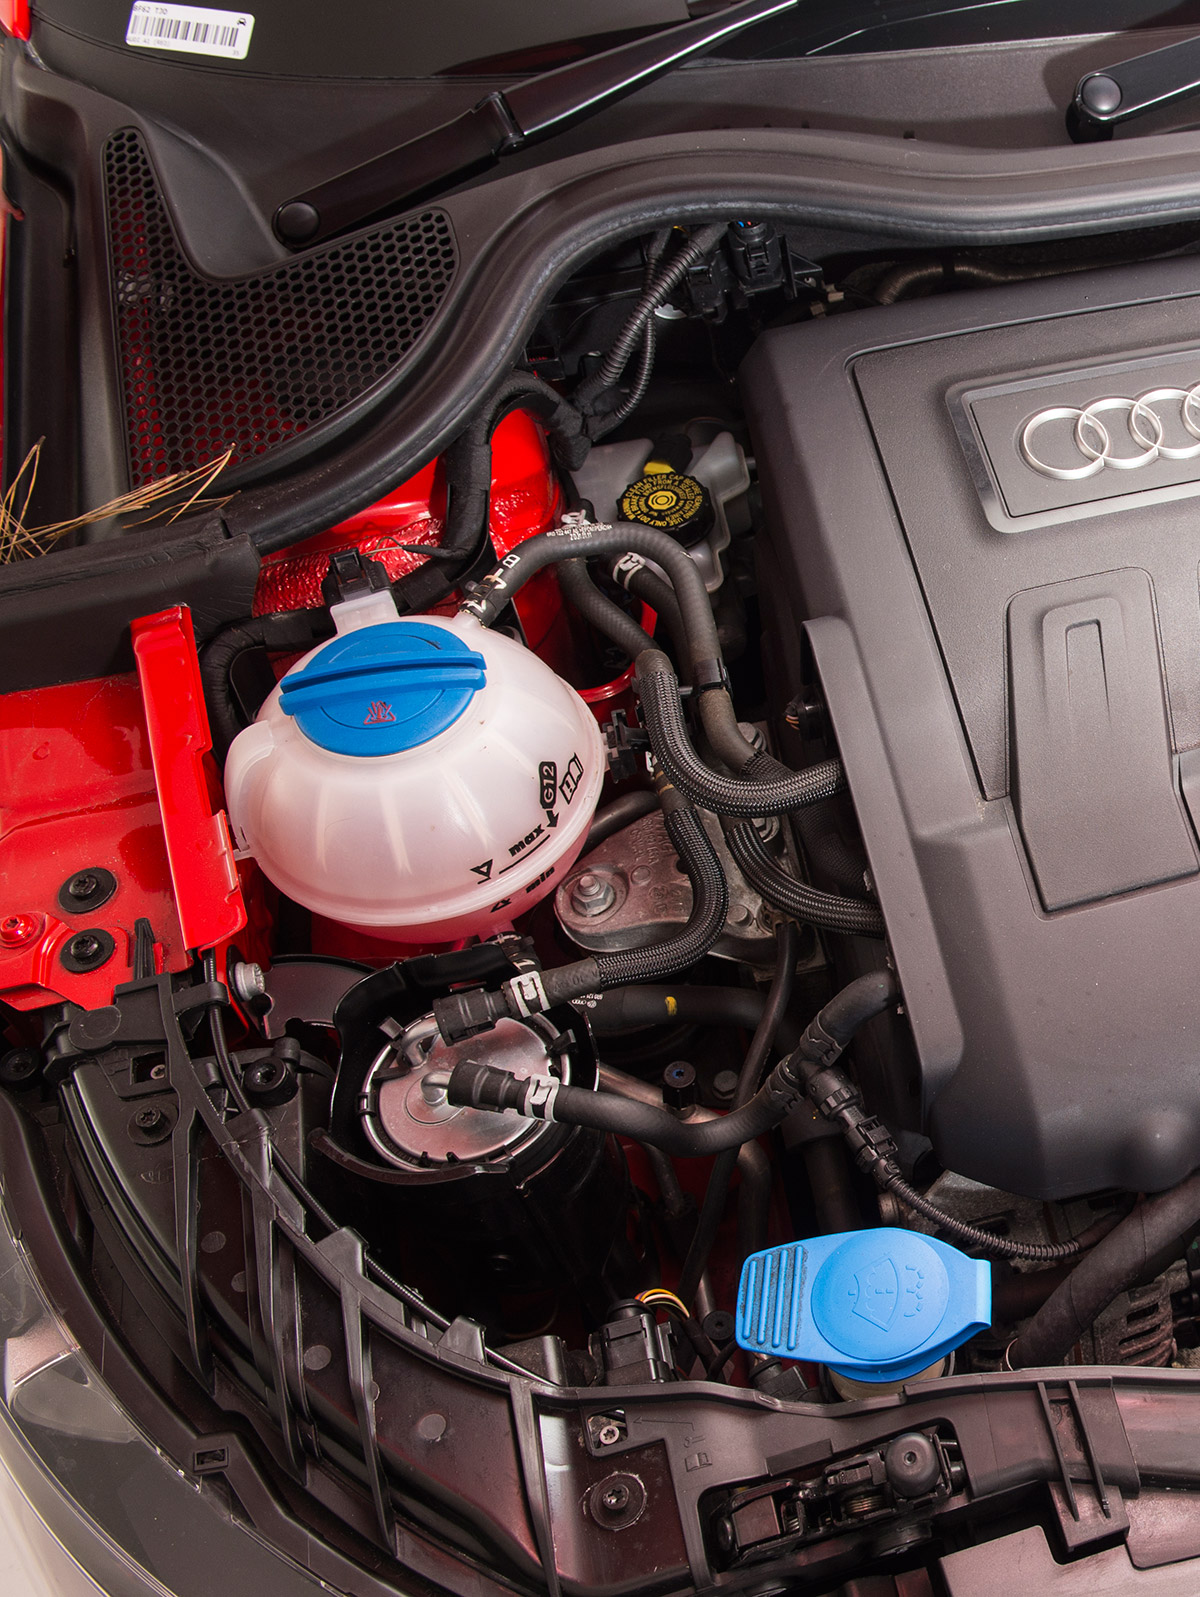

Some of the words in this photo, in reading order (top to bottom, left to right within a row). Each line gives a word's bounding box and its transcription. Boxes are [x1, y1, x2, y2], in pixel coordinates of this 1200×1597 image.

[625, 482, 644, 498] CLEAN
[644, 474, 667, 484] FILLER
[635, 483, 653, 495] FLUID
[630, 495, 640, 512] BRAKE
[637, 513, 651, 524] DOT
[649, 519, 667, 527] ONLY
[669, 517, 684, 527] USE
[542, 765, 555, 803] G12
[508, 823, 545, 857] max
